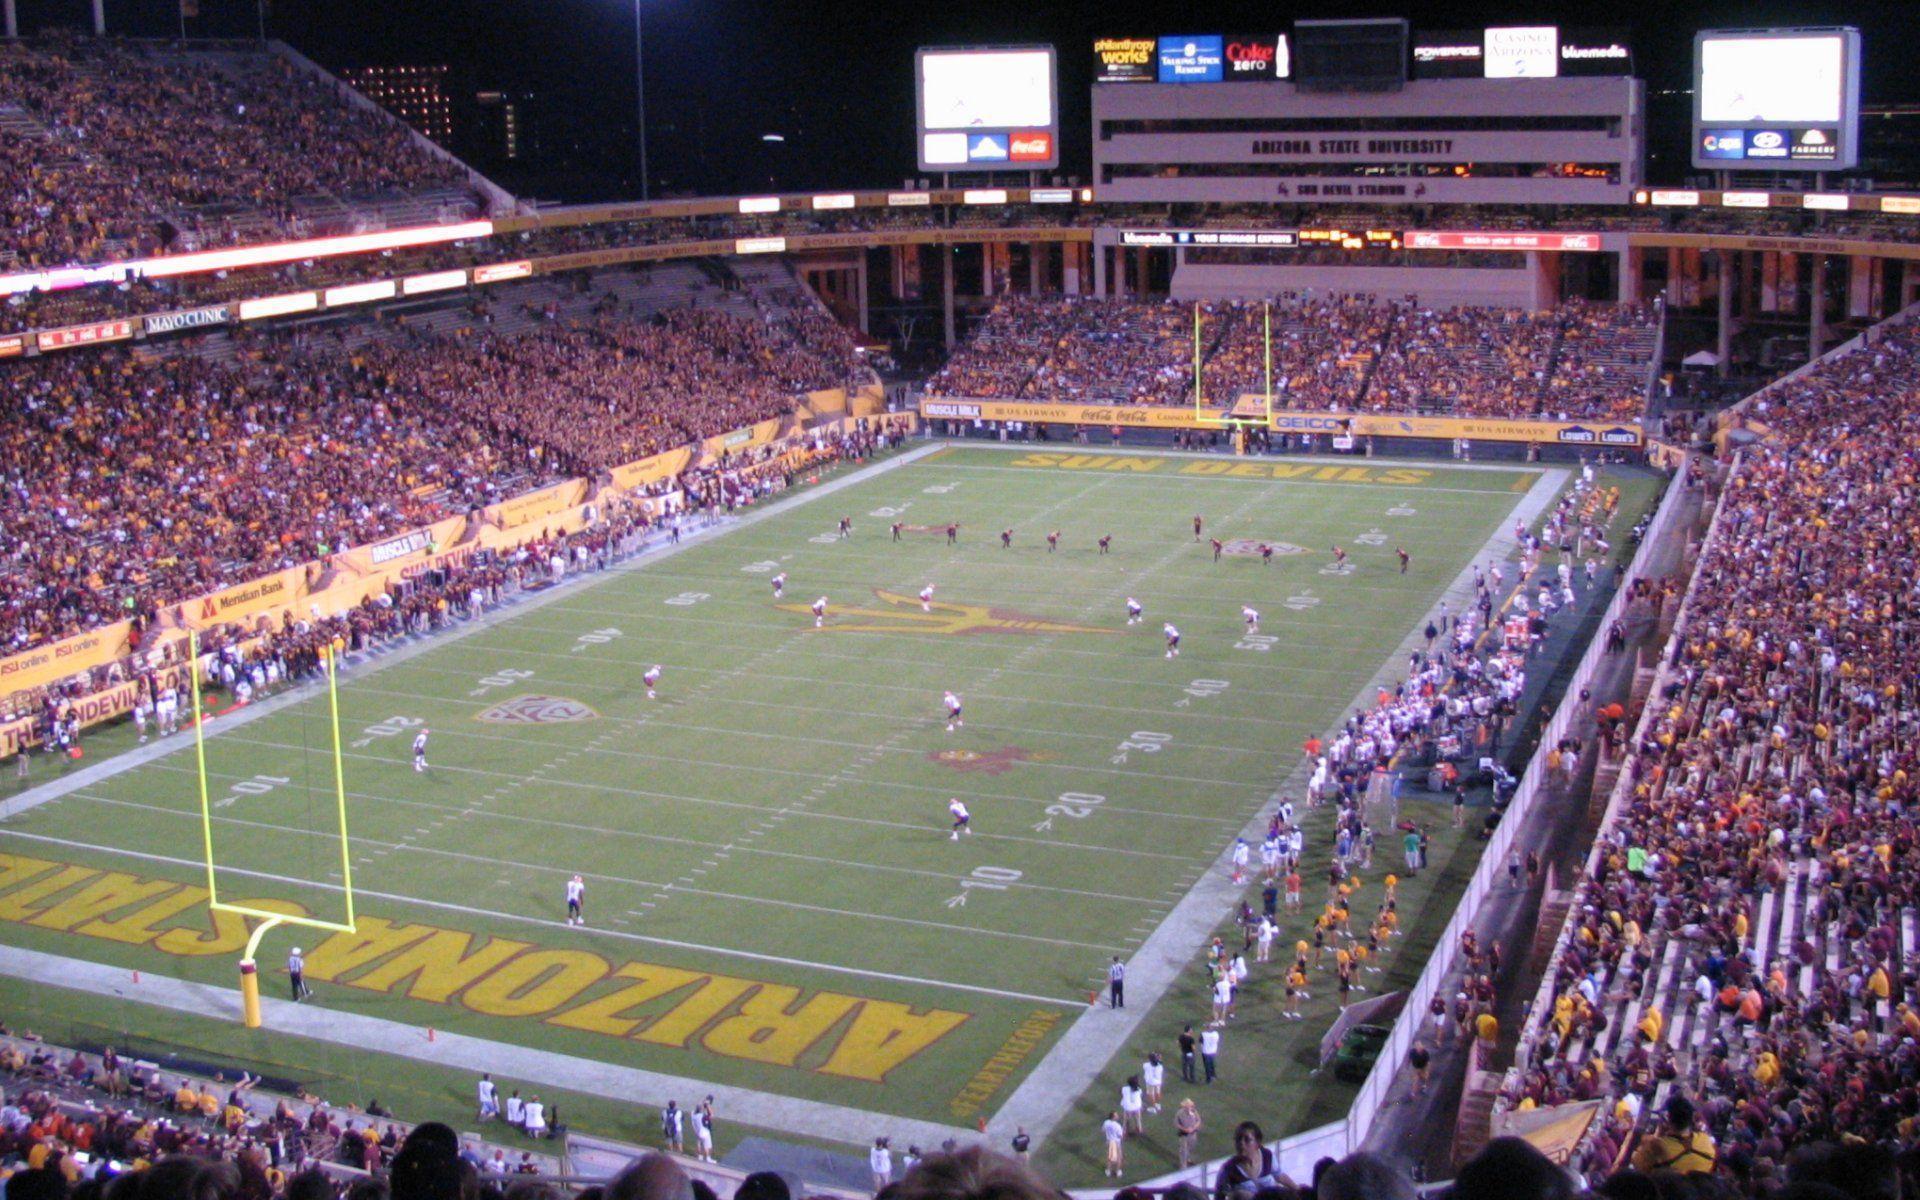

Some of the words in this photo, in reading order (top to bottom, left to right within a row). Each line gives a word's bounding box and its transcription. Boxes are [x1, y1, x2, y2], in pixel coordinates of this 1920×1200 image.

[1094, 39, 1156, 53] philanthropy
[1226, 43, 1273, 61] Coke
[1561, 44, 1628, 59] bluemedia
[1102, 50, 1149, 64] works
[1234, 59, 1266, 71] zero
[1252, 139, 1311, 155] ARIZONA
[1319, 139, 1360, 155] STATE
[1368, 139, 1453, 154] UNIVERSITY
[149, 312, 184, 333] MAYO
[186, 307, 228, 326] CLINIC
[1023, 407, 1066, 418] AIRWAYS
[1276, 416, 1338, 430] GEICO
[1011, 454, 1167, 472] SUN
[1180, 460, 1434, 484] DEVILS
[220, 589, 260, 609] Meridian
[260, 580, 284, 596] Bank
[363, 715, 426, 737] 20
[1116, 731, 1173, 752] 30
[230, 775, 290, 796] 10
[1044, 792, 1106, 818] 20
[960, 866, 1023, 890] 10
[279, 914, 974, 1084] ARIZONA
